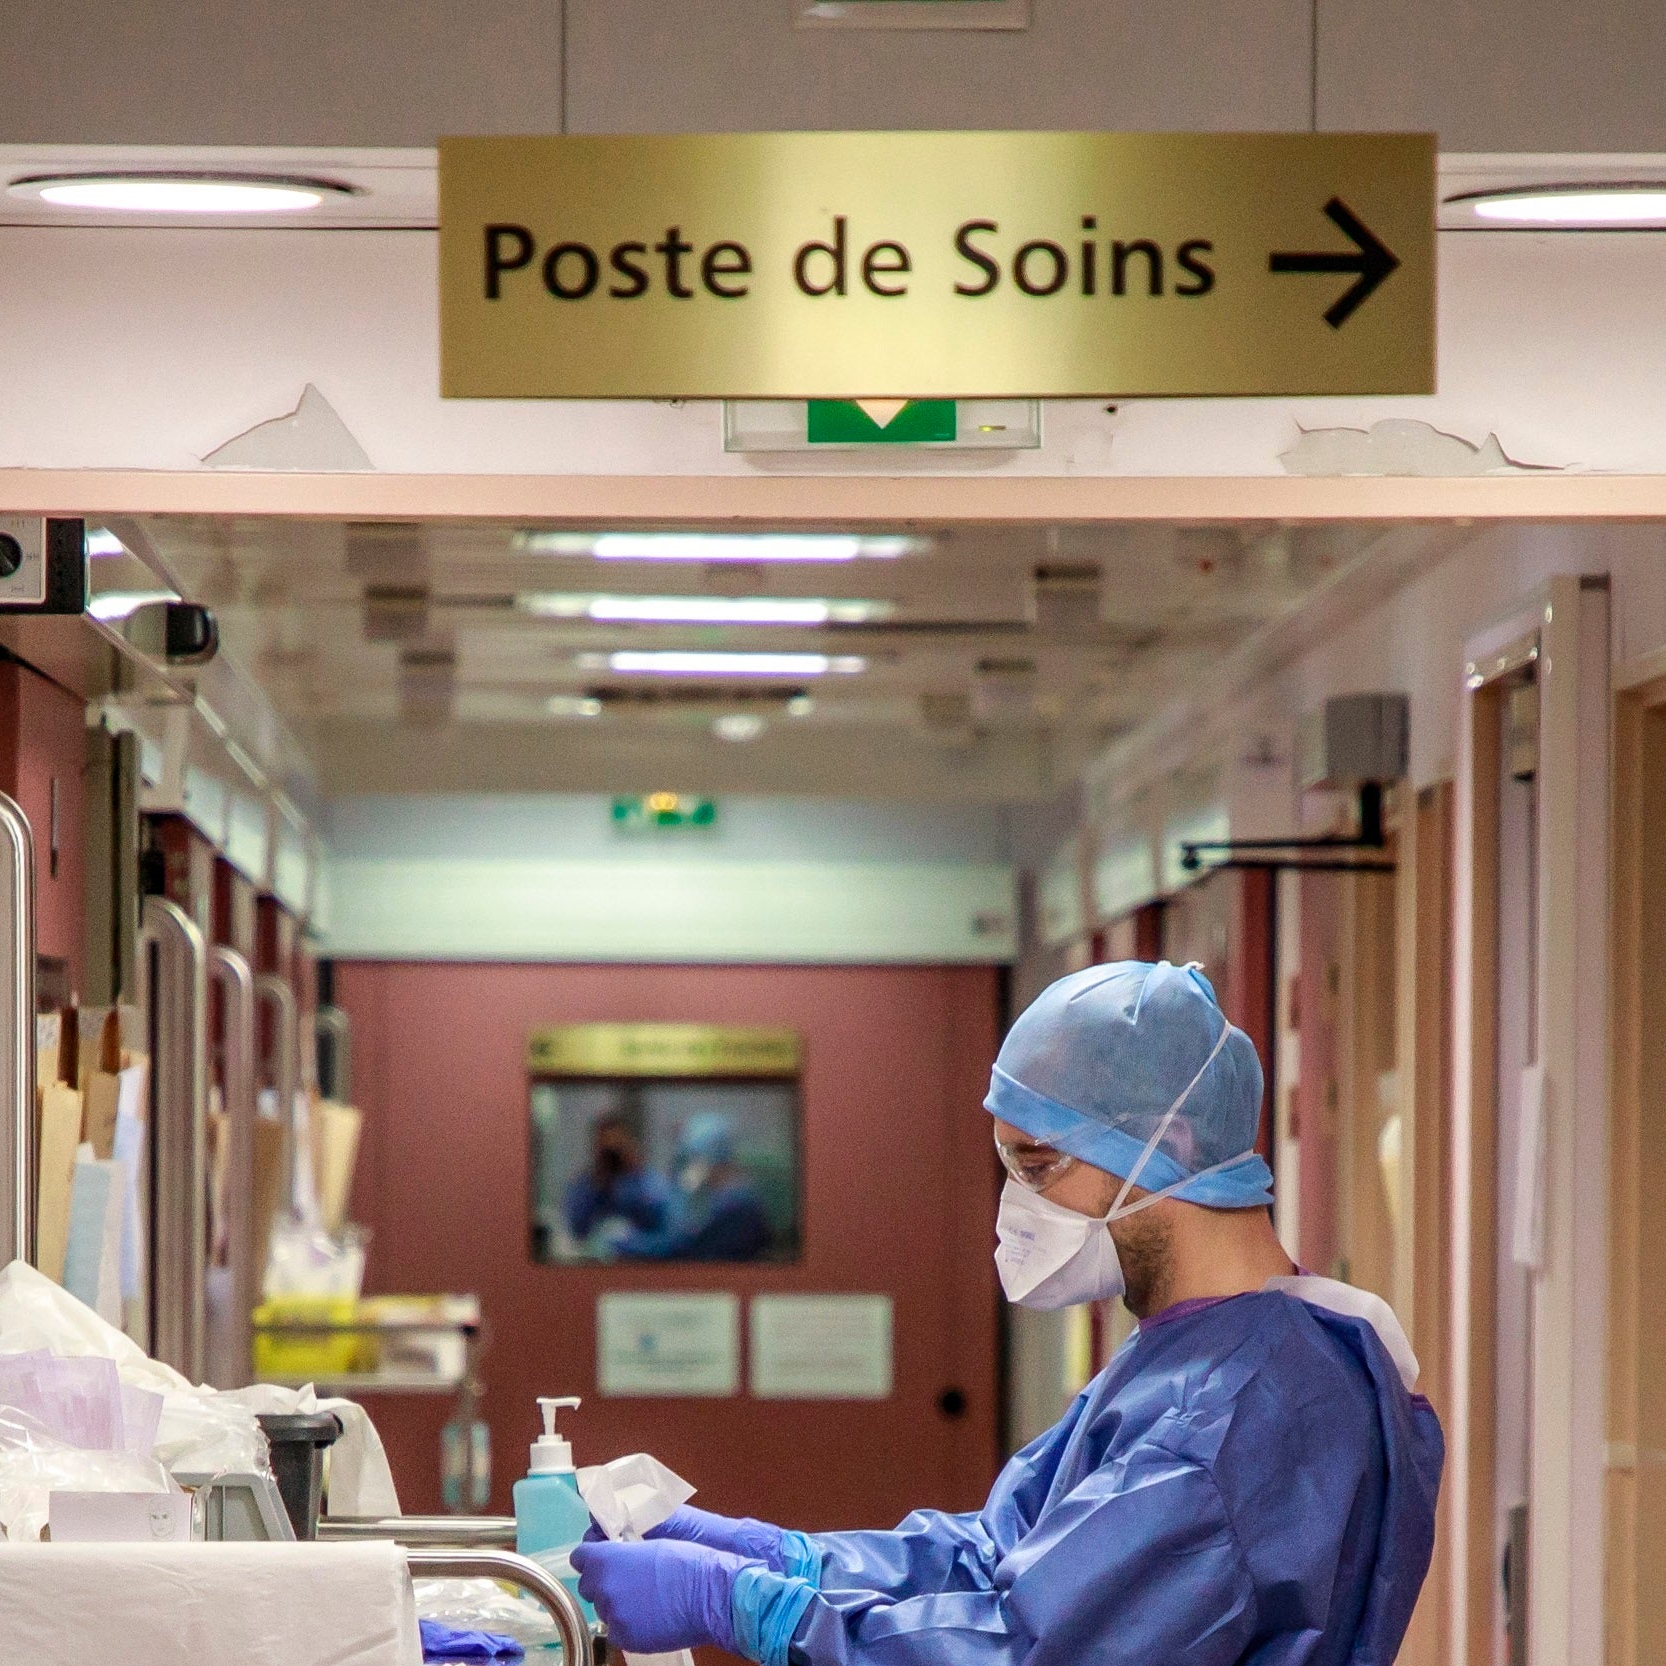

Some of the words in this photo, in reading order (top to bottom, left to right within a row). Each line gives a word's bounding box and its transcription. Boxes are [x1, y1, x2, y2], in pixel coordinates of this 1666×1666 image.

[482, 222, 751, 302] Poste
[795, 218, 909, 297] de
[956, 216, 1217, 299] Soins
